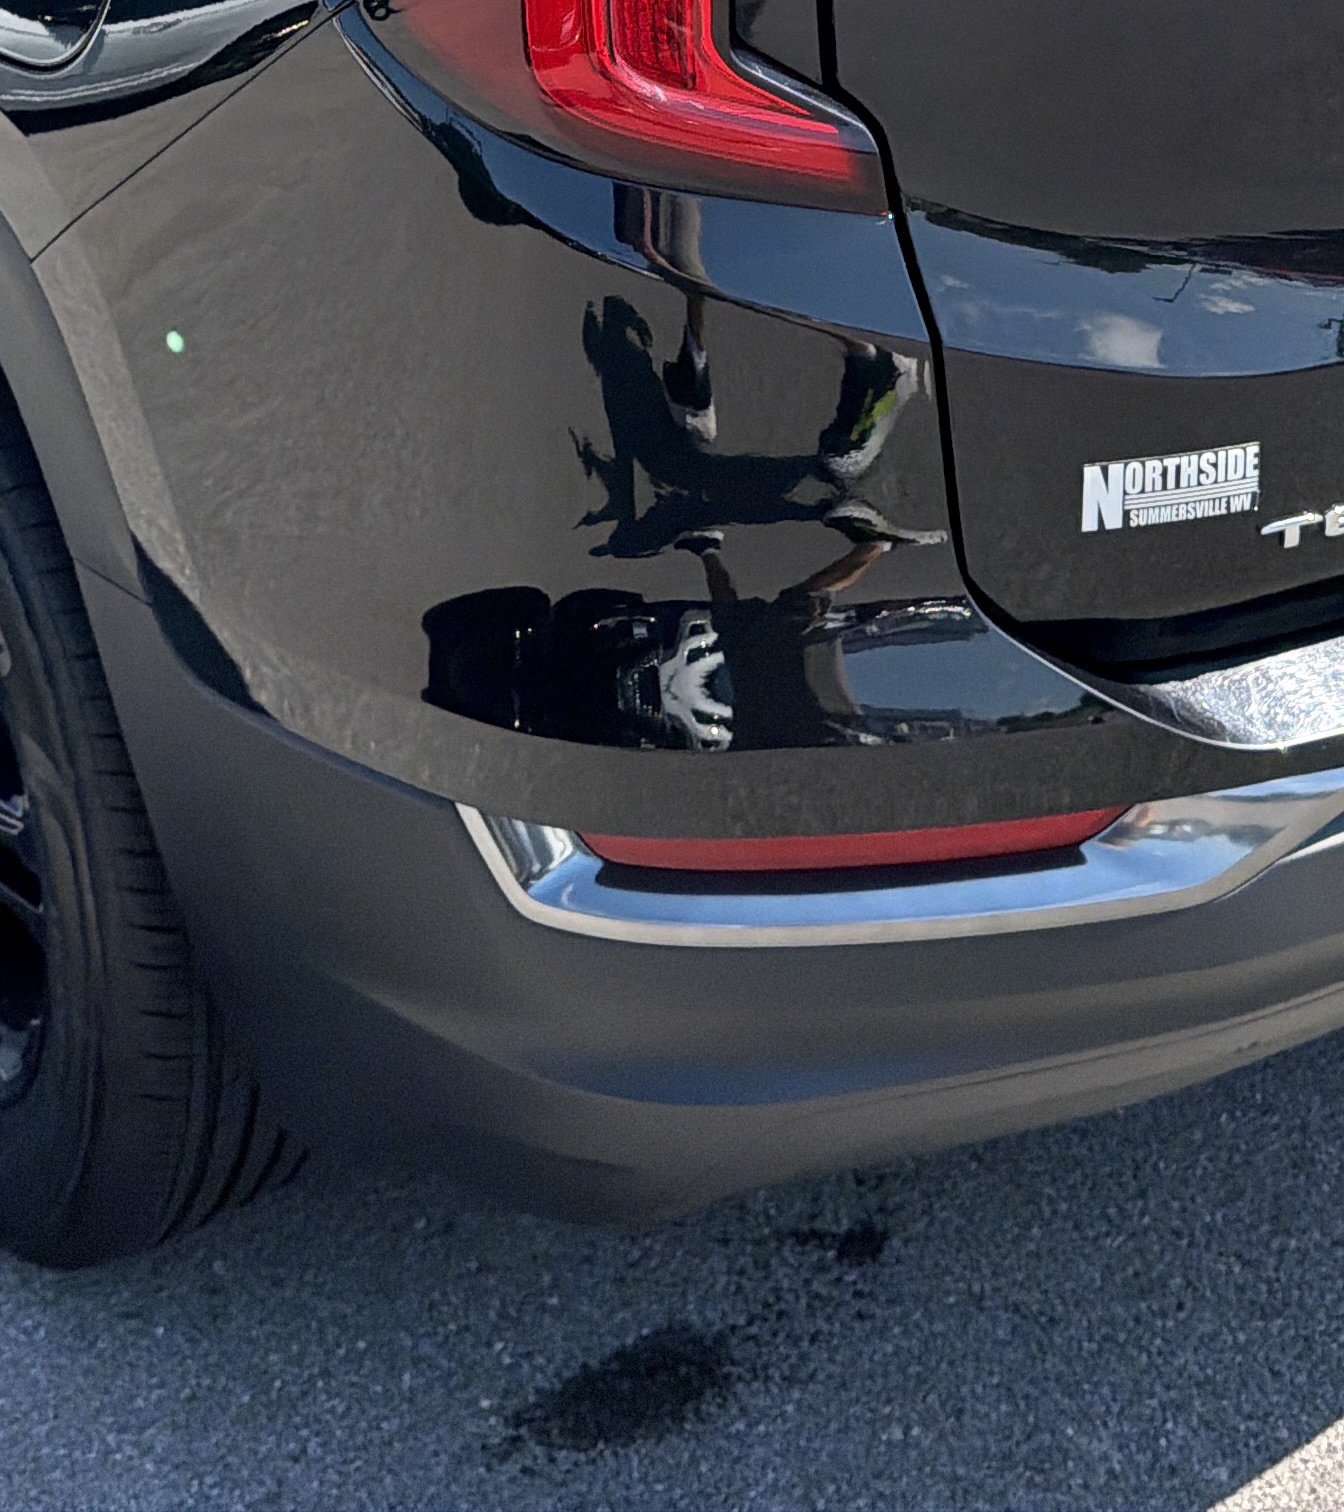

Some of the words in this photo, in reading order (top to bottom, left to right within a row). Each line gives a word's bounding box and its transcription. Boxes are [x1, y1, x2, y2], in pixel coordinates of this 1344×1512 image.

[1081, 445, 1260, 533] NORTHSIDE
[1129, 497, 1228, 528] SUMMERSVILLE
[1229, 493, 1253, 513] WV
